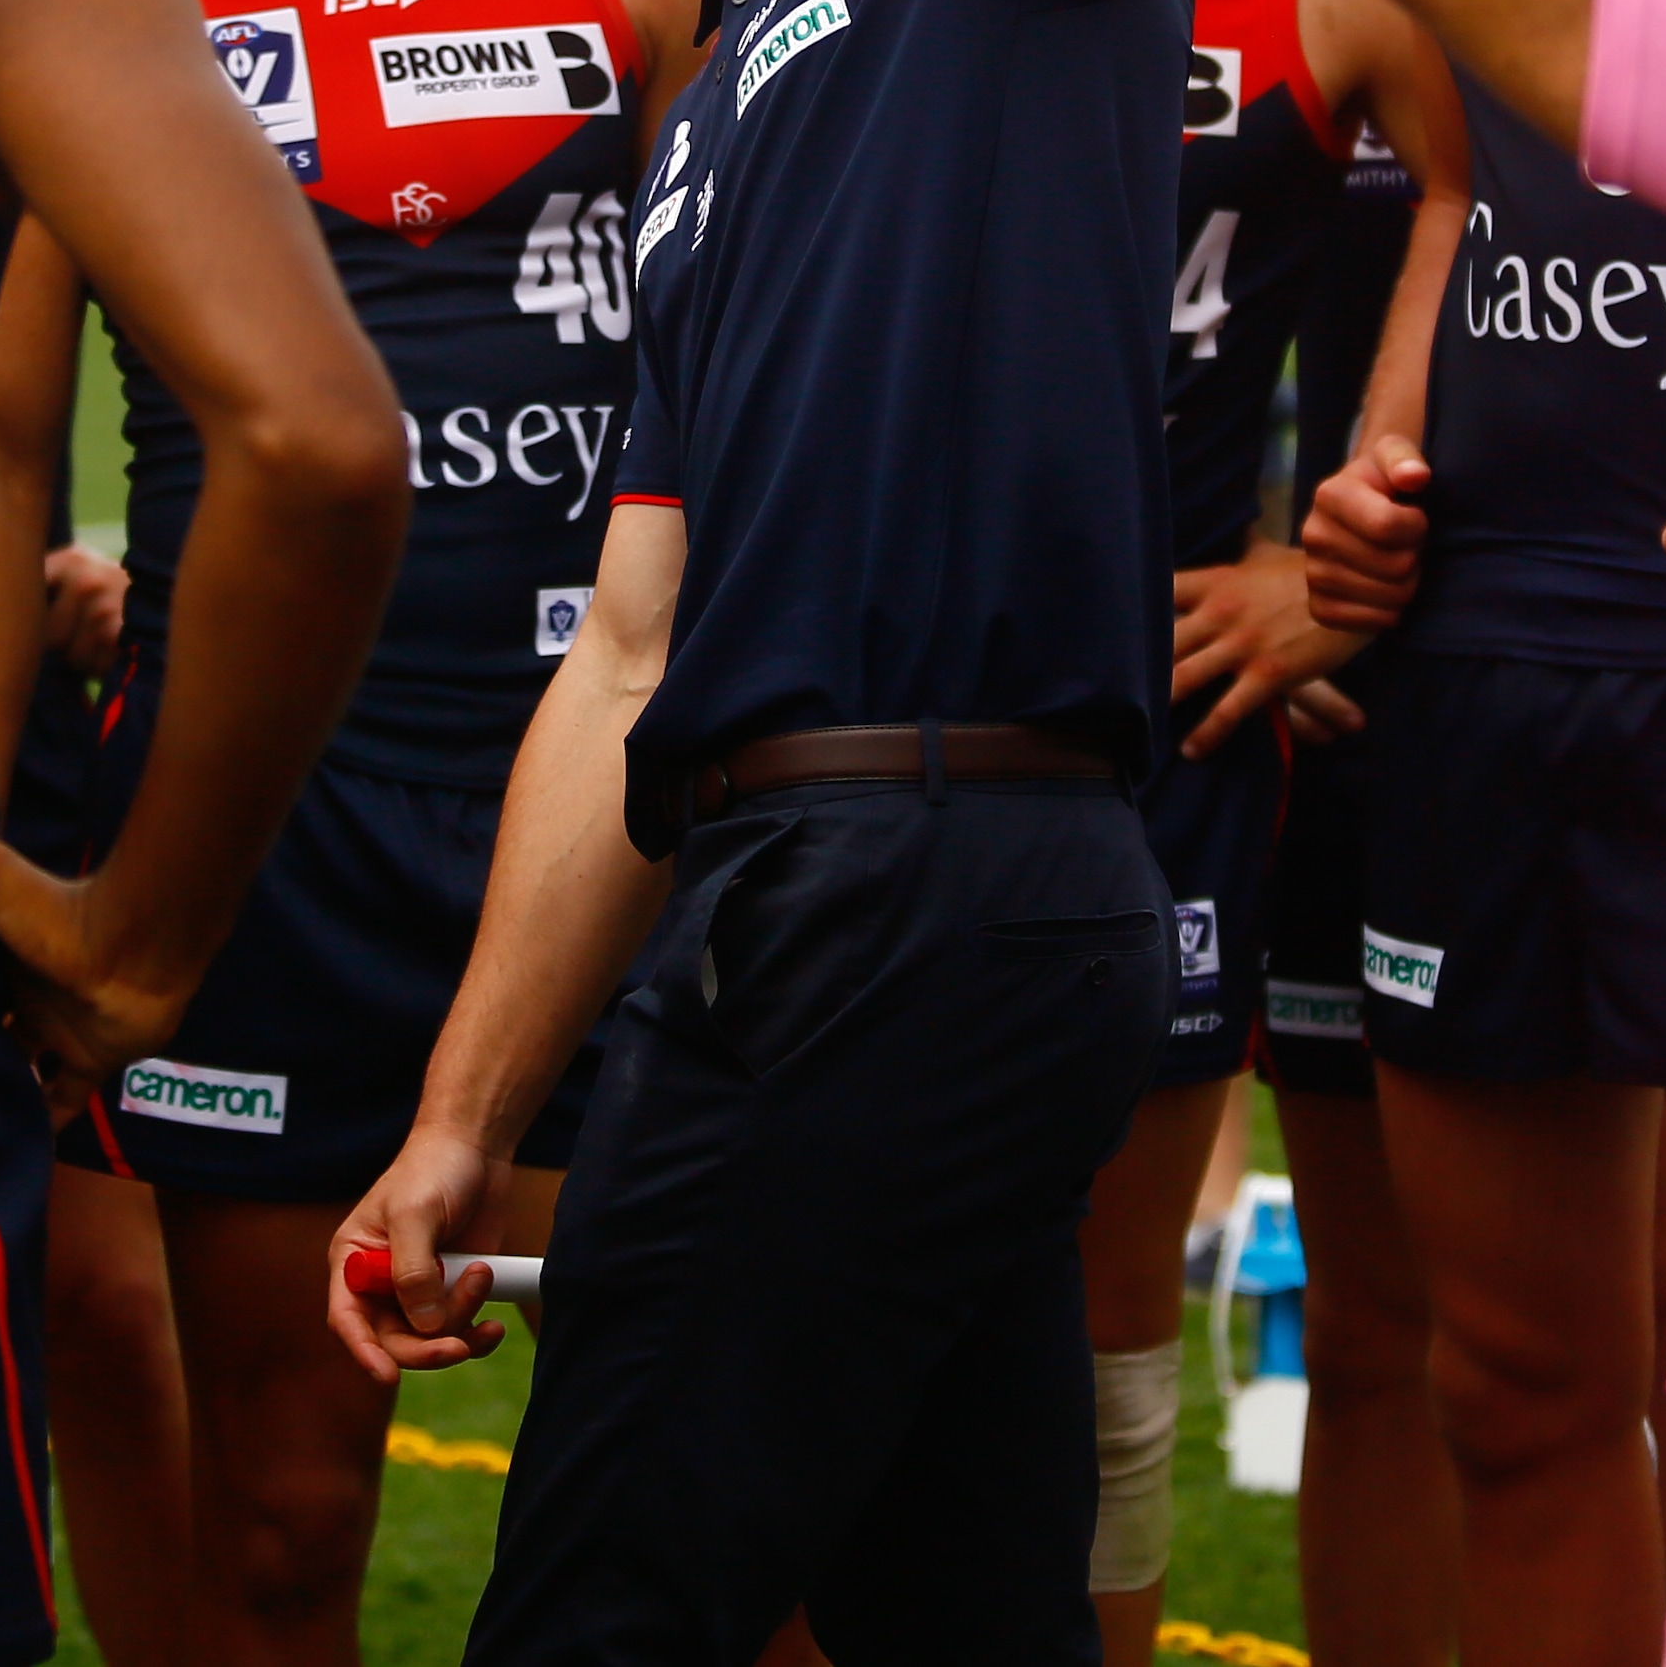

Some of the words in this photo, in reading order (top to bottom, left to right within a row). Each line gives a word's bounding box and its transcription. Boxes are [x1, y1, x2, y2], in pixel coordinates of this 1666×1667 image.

[215, 26, 259, 43] AFL
[380, 40, 534, 84] BROWN
[416, 77, 488, 96] PROPERTY
[492, 74, 540, 89] GROUP
[513, 191, 632, 344] 40
[125, 1068, 281, 1120] cameron.
